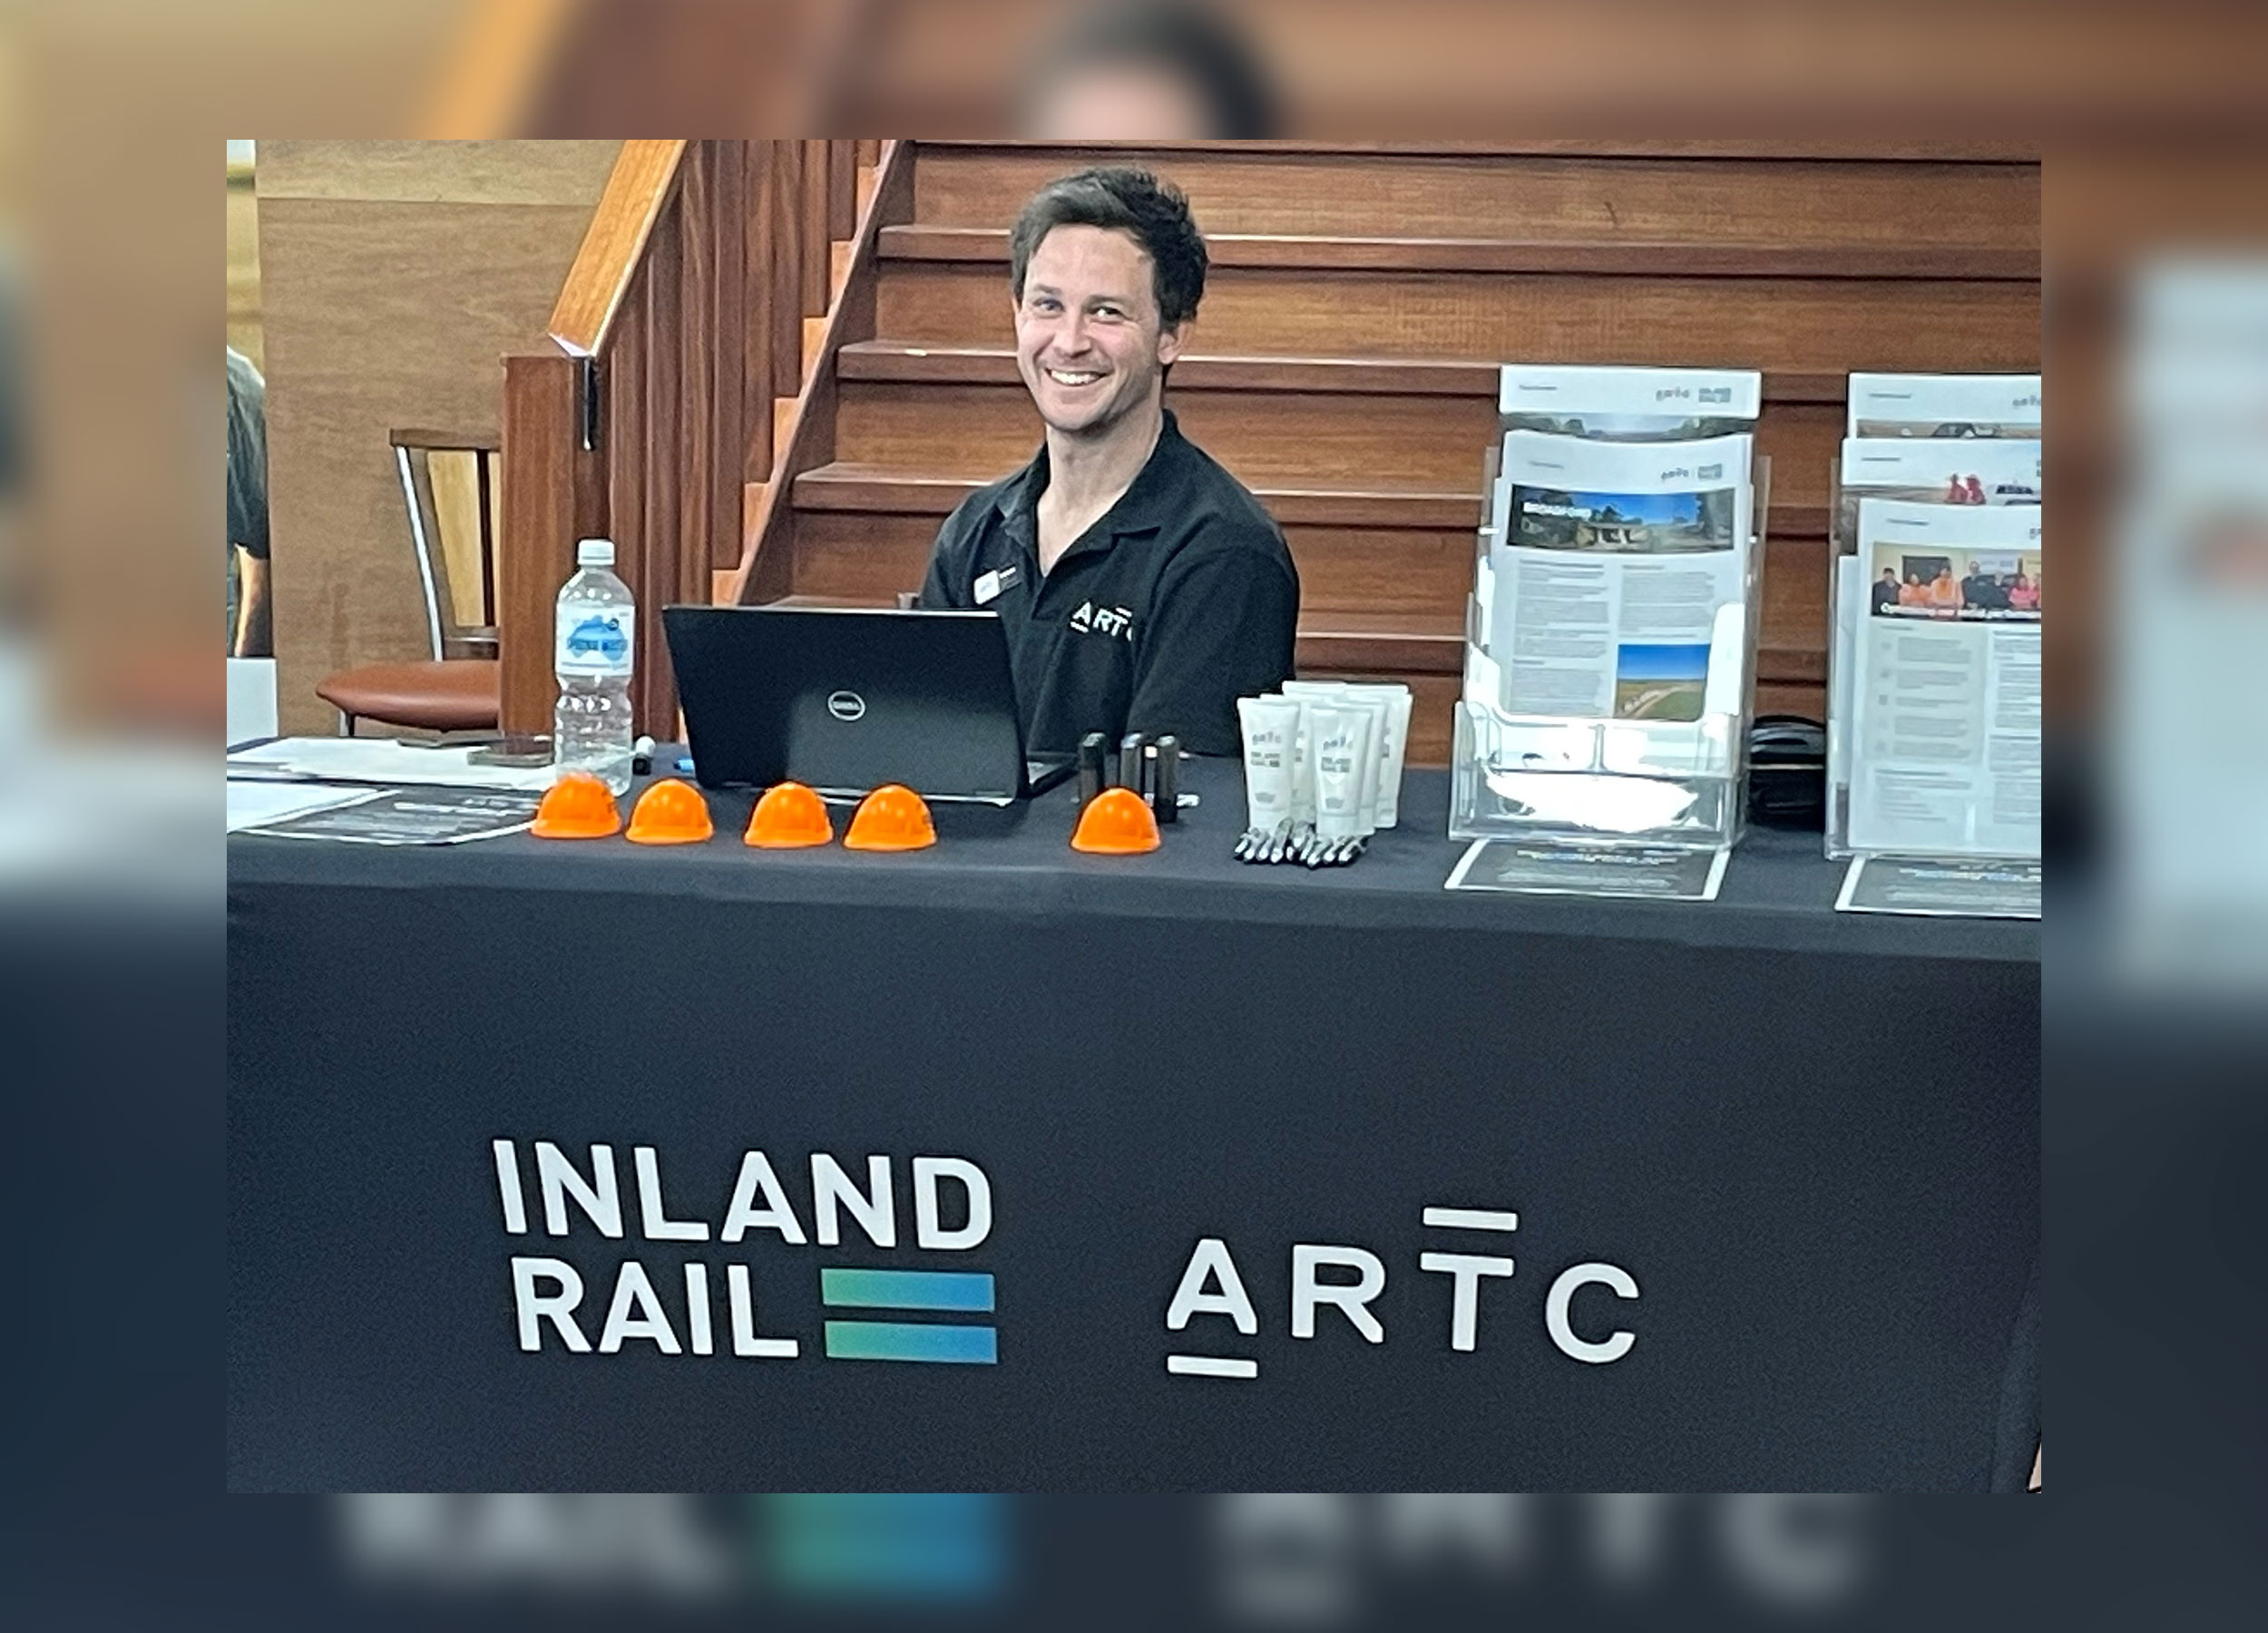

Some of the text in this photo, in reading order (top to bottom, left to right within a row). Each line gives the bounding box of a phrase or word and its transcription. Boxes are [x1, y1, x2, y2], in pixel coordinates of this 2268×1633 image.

[493, 1139, 992, 1250] INLAND
[511, 1257, 799, 1357] RAIL
[1167, 1208, 1639, 1378] ARTC
